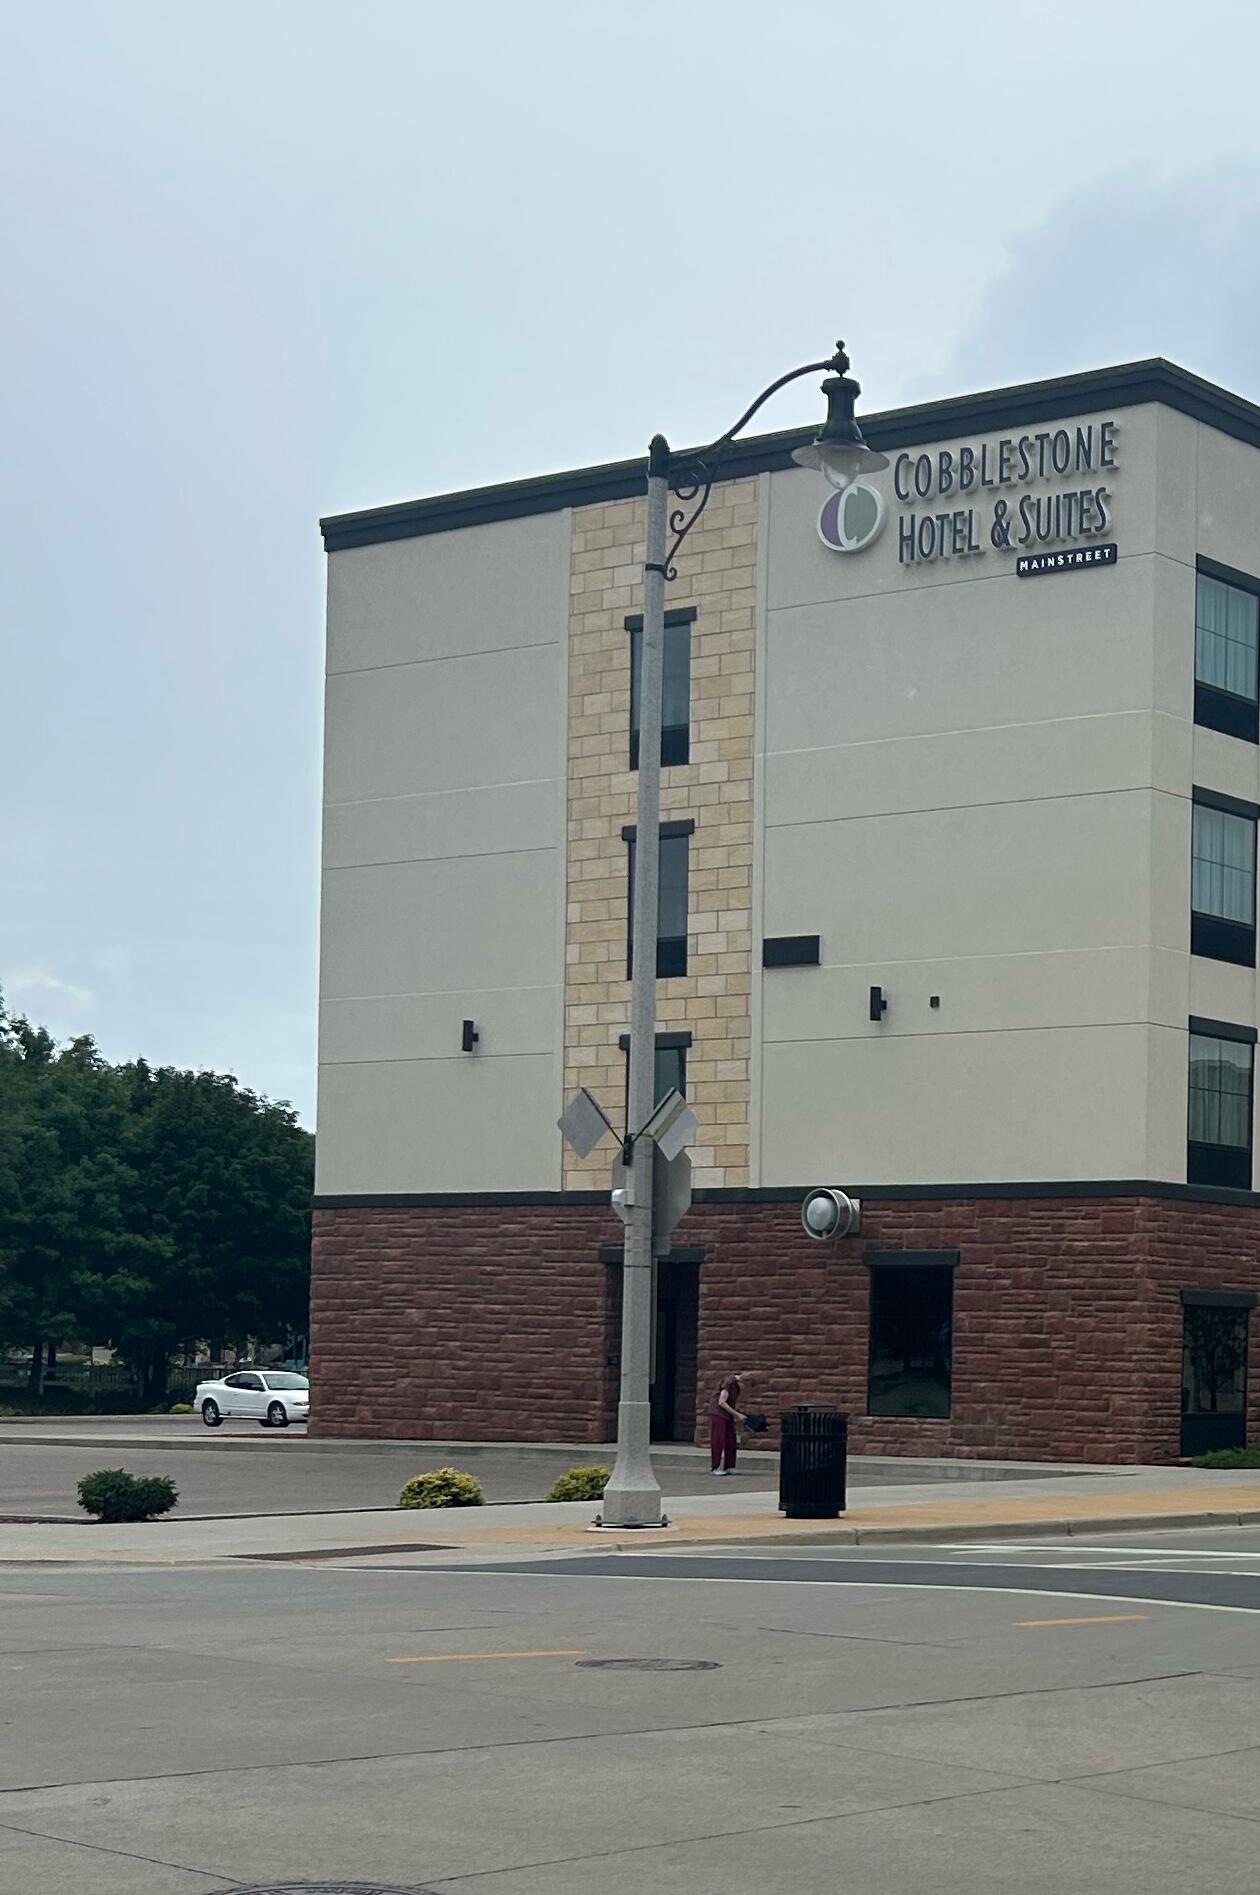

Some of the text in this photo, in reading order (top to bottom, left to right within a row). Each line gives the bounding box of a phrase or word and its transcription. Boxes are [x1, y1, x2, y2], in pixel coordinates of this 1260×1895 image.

[894, 421, 1116, 501] COBBLESTONE
[899, 486, 1109, 563] HOTEL & SUITES
[1019, 548, 1111, 571] MAINSTREET
